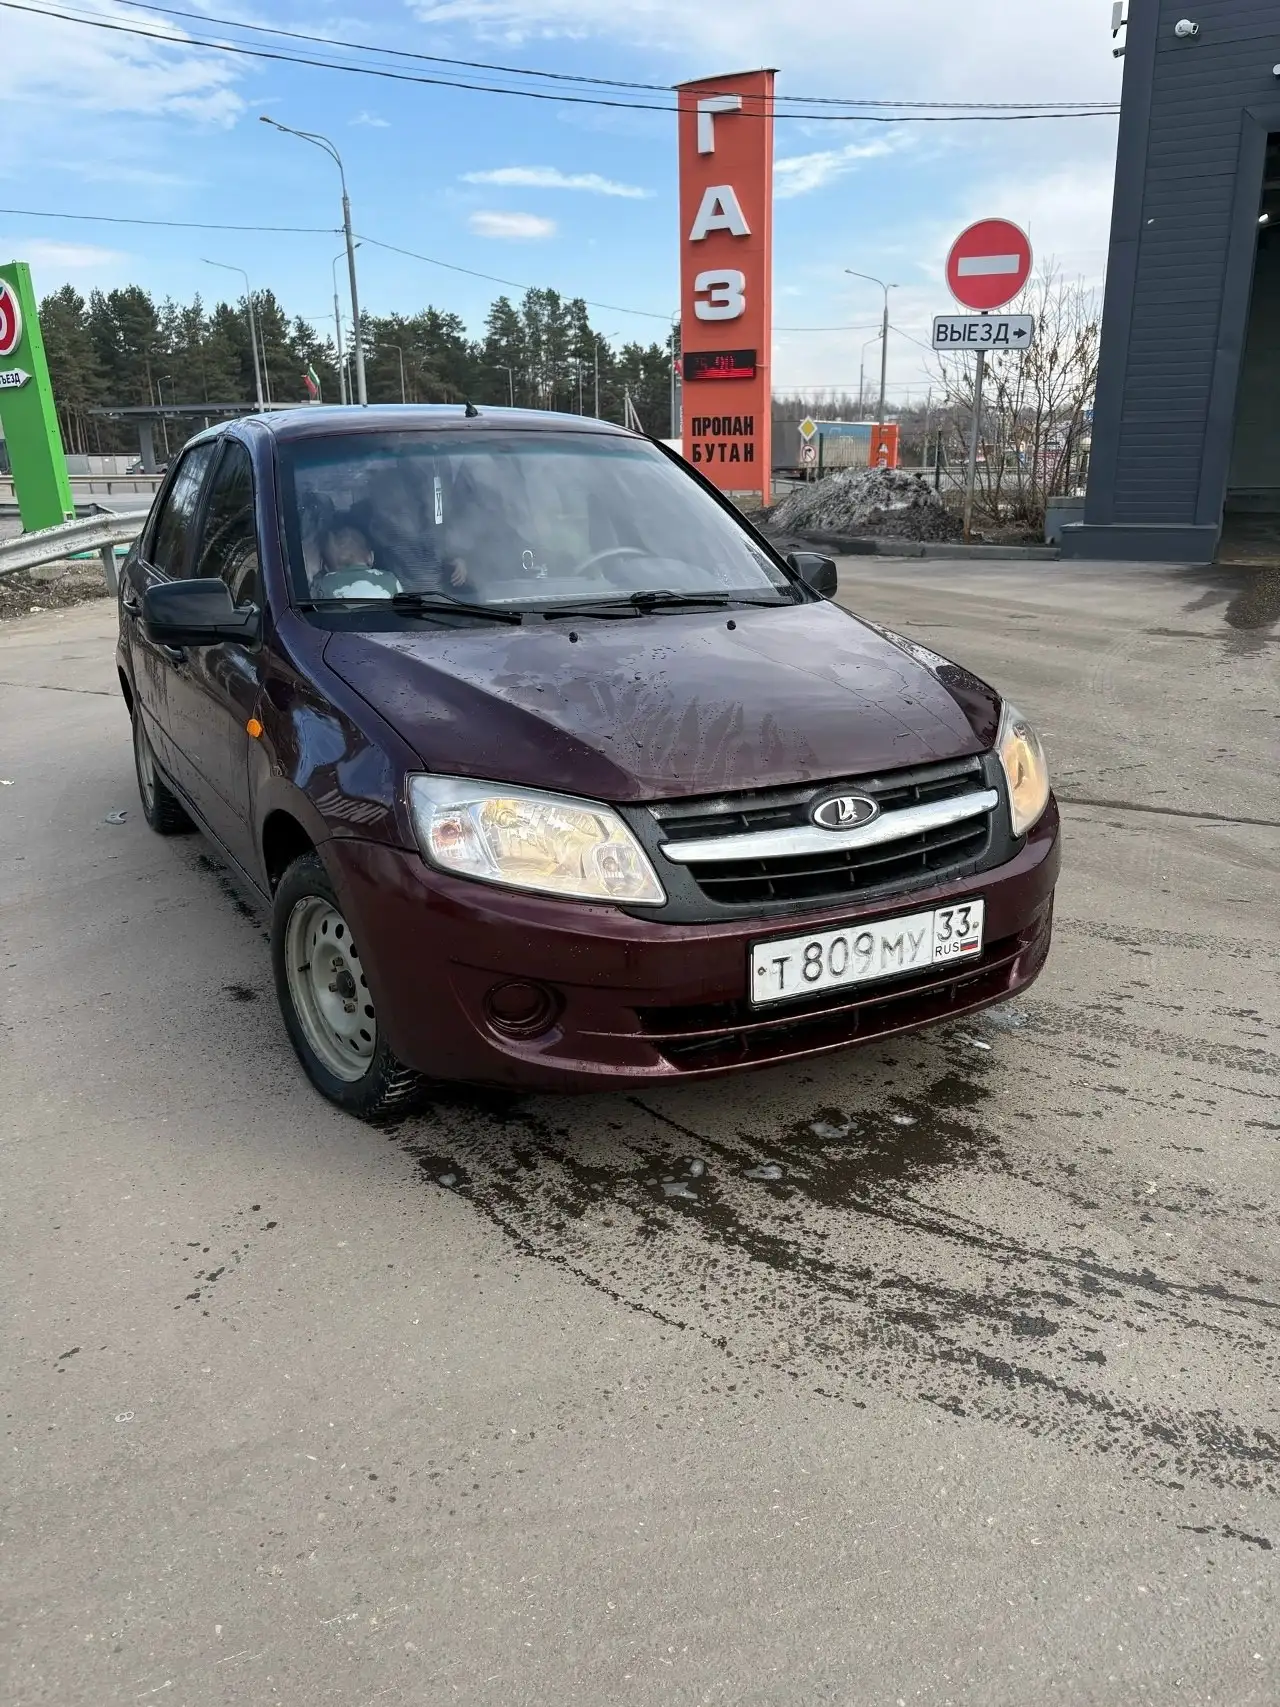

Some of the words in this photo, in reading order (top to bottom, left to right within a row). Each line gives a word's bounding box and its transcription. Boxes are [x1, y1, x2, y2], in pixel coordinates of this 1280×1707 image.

[689, 95, 751, 321] ГАЗ
[936, 323, 1010, 344] ВЫЕЗД
[0, 373, 21, 384] ЪЕЗД
[692, 416, 754, 436] ПРОПАН
[692, 443, 754, 463] БУТАН
[937, 907, 972, 942] 33
[935, 943, 960, 957] RUS
